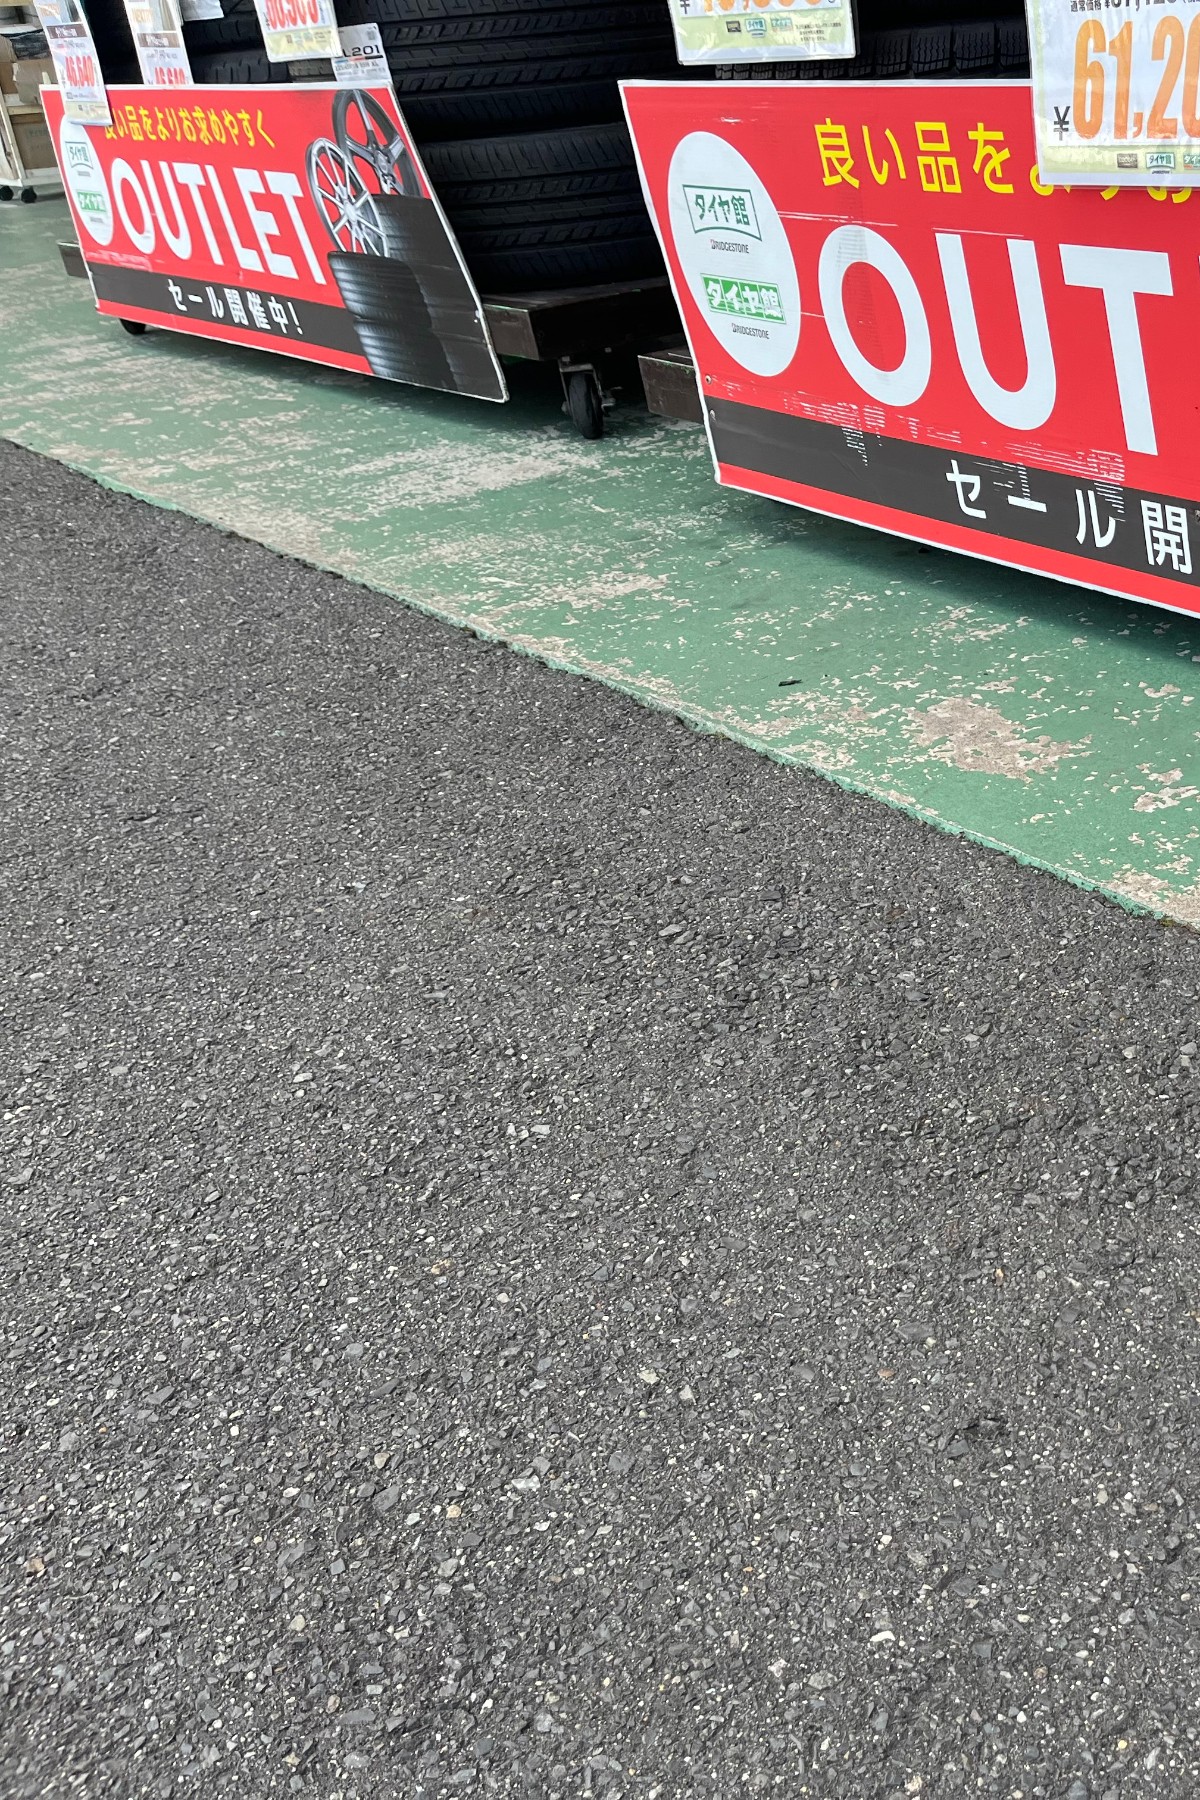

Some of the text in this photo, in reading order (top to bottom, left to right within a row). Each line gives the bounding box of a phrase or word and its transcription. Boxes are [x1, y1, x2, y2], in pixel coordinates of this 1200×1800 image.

[111, 157, 327, 286] OUTLET
[694, 194, 751, 227] タイヤ館
[710, 239, 750, 255] BRIDGESTONE
[706, 279, 783, 319] タイヤ館
[731, 322, 770, 340] BRIDGESTONE
